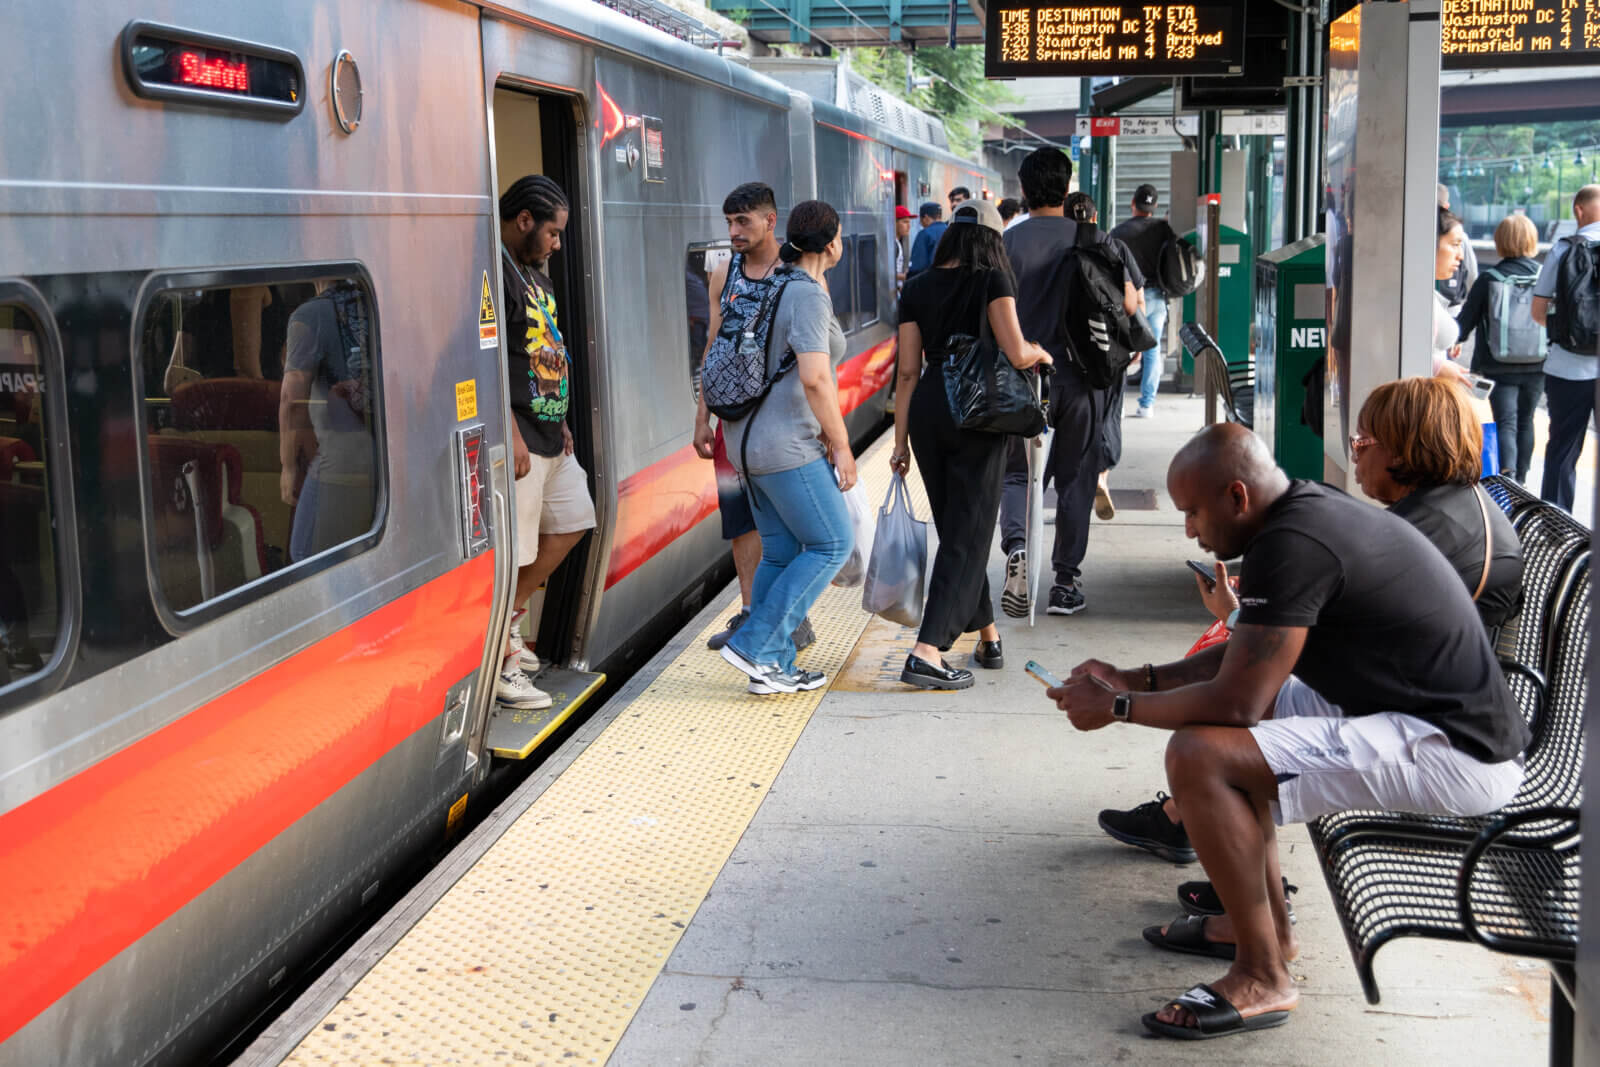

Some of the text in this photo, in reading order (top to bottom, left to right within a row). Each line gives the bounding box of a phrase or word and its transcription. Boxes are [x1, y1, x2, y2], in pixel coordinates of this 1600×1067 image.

[1000, 6, 1195, 22] TIME DESTINATION TK ETA
[1443, 0, 1534, 13] DESTINATION
[1443, 13, 1528, 26] Washington
[1536, 10, 1555, 23] DC
[1561, 9, 1571, 22] 2
[1002, 19, 1198, 35] 5:38 Washington DC 2 7:45
[1442, 24, 1515, 40] Stamford
[1560, 22, 1572, 35] 4
[1002, 31, 1222, 48] 7:20 Stamford 4 Arrived
[1442, 37, 1523, 54] Springfield
[1531, 36, 1552, 50] MA
[1560, 36, 1571, 49] 4
[1002, 45, 1195, 61] 7:32 Springfield MA 4 7:33
[1095, 119, 1115, 127] Exit
